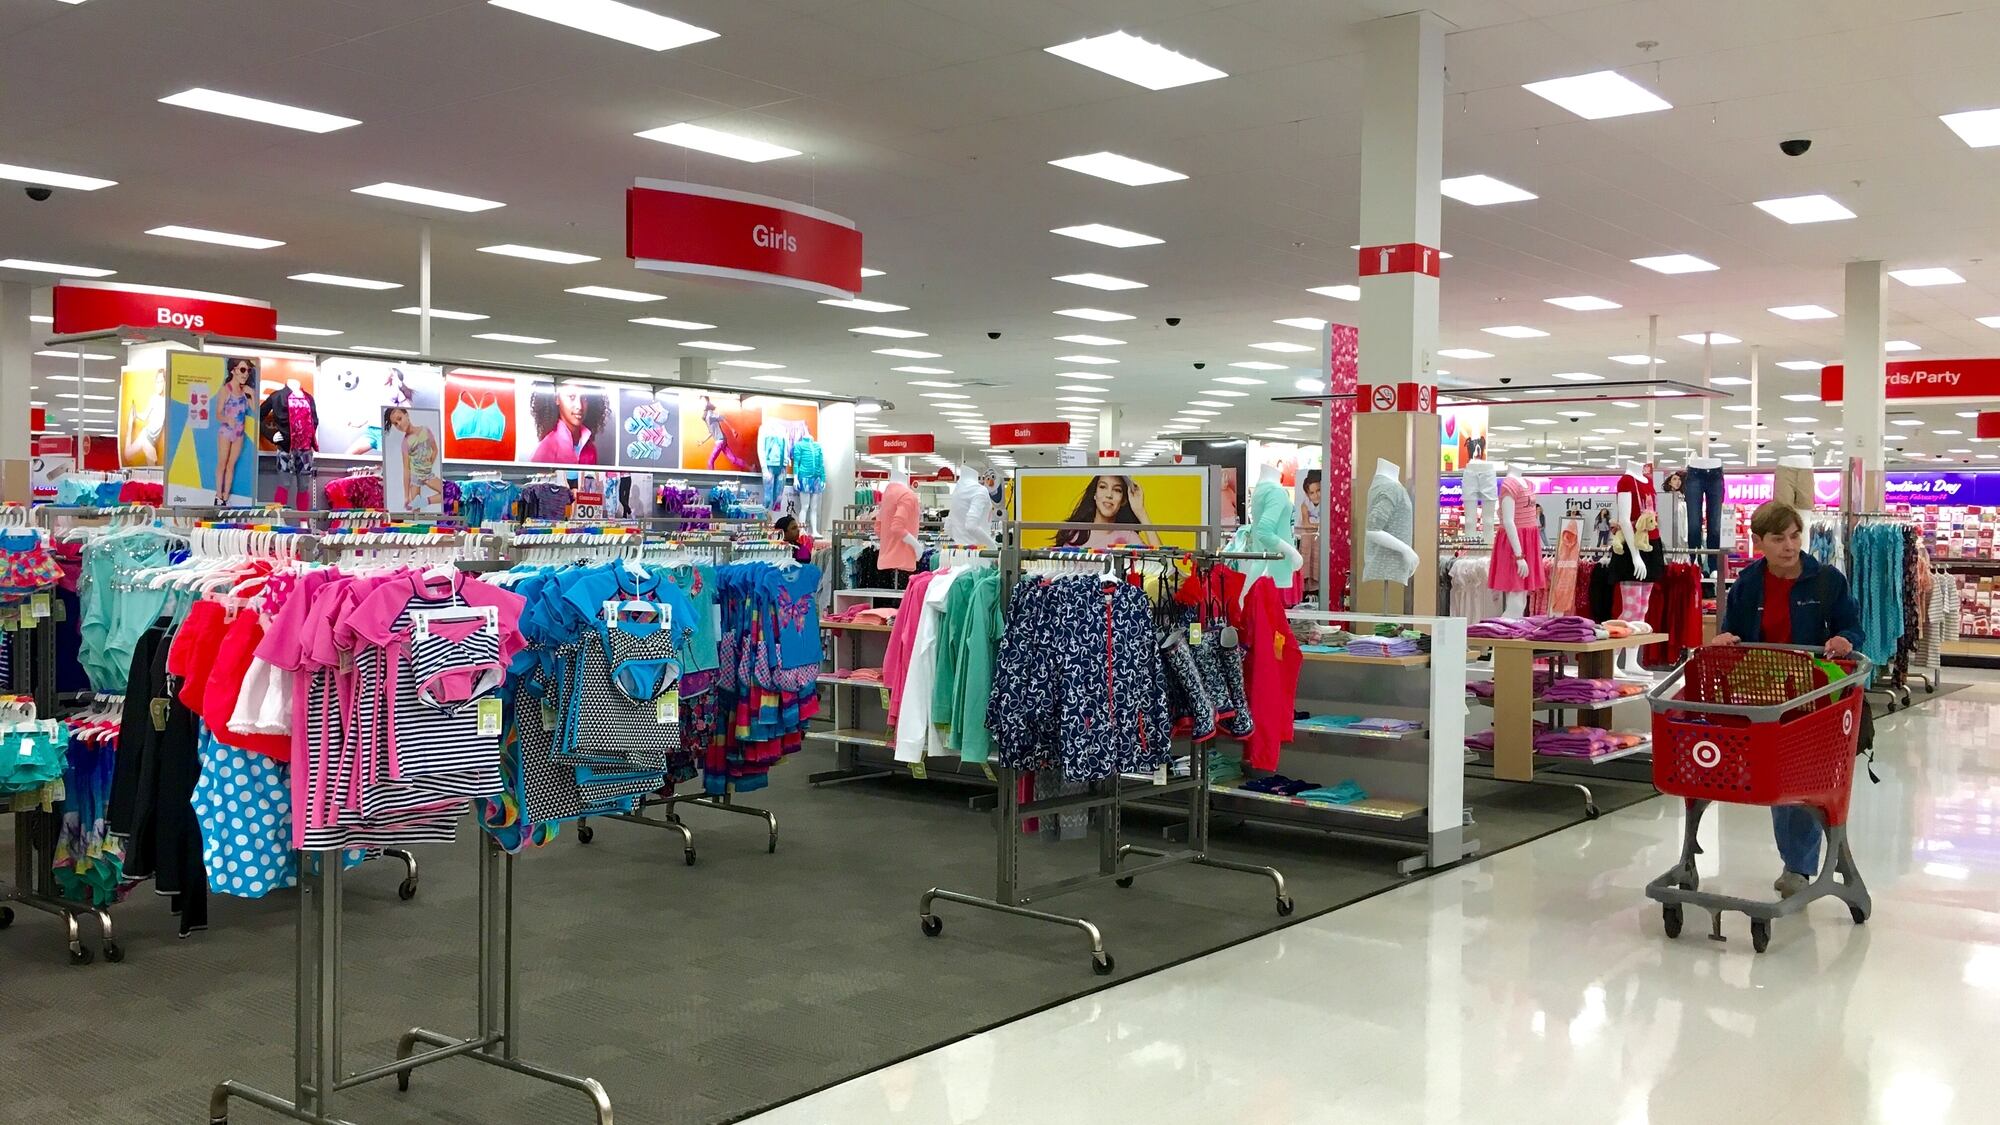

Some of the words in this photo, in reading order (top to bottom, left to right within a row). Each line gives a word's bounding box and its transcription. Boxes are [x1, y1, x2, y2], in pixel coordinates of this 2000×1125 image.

[752, 224, 797, 252] Girls
[157, 307, 204, 329] Boys
[1884, 370, 1961, 386] rds/Party
[1014, 429, 1031, 437] Bath
[883, 439, 908, 449] Bedding
[1932, 479, 1962, 495] Day
[1565, 498, 1592, 510] find
